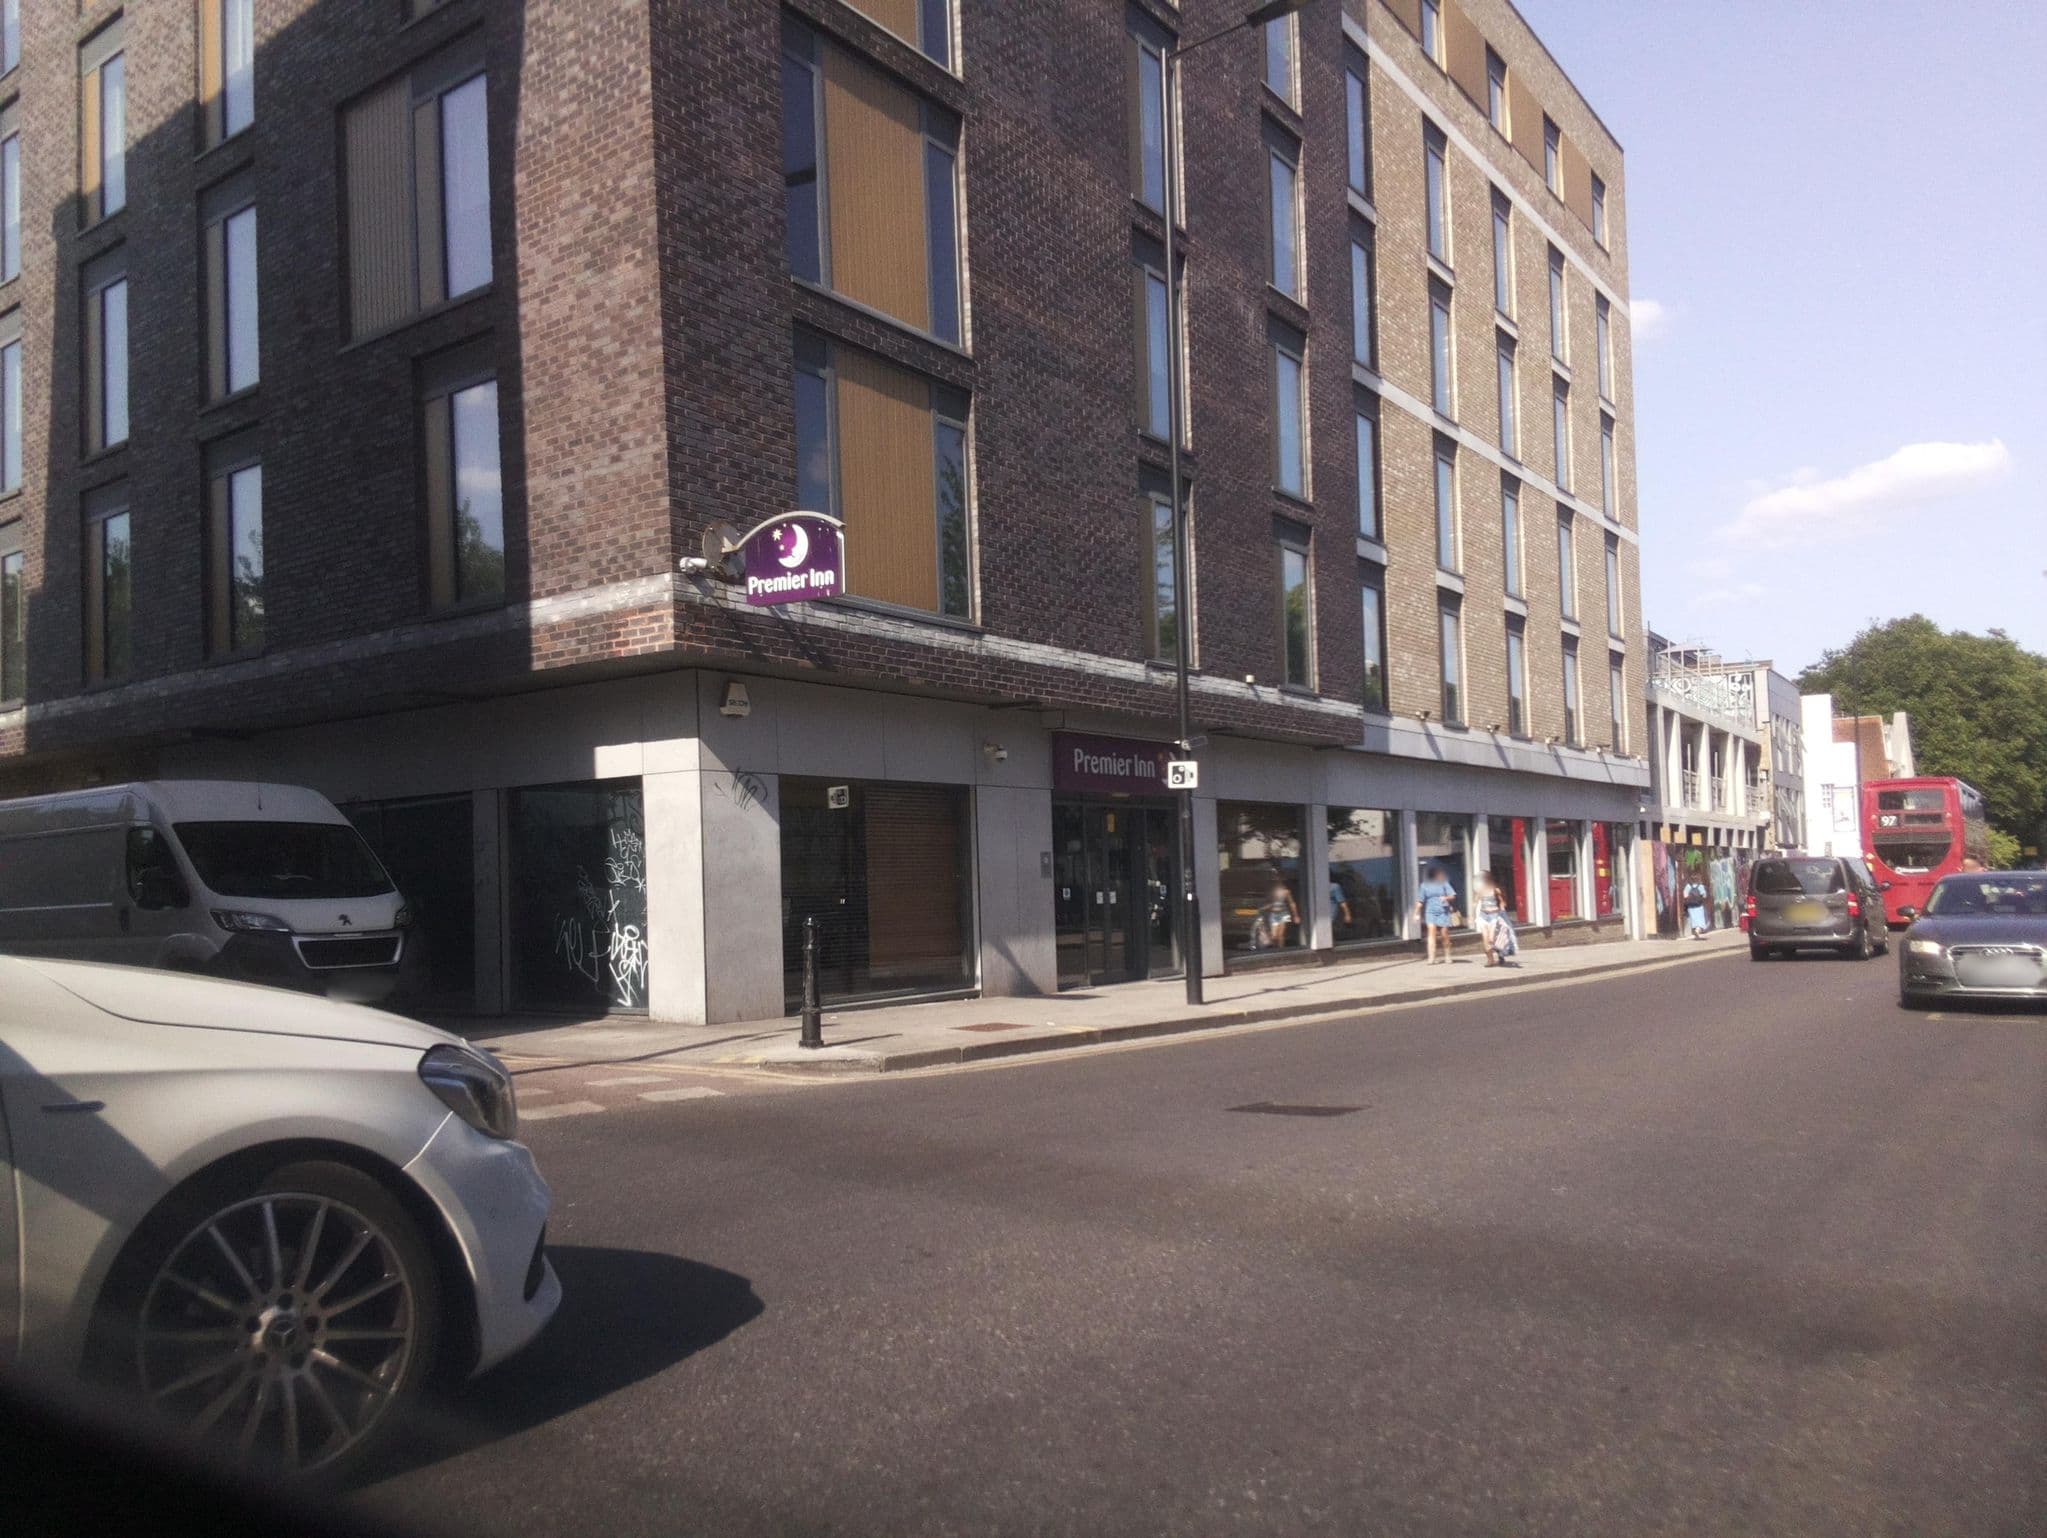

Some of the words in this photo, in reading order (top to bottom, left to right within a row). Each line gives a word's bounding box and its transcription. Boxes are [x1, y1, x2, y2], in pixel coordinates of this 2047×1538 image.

[748, 571, 808, 595] Premier
[810, 568, 835, 587] Inn
[1074, 748, 1133, 776] Premier
[1134, 754, 1156, 778] Inn
[1881, 815, 1897, 827] 97
